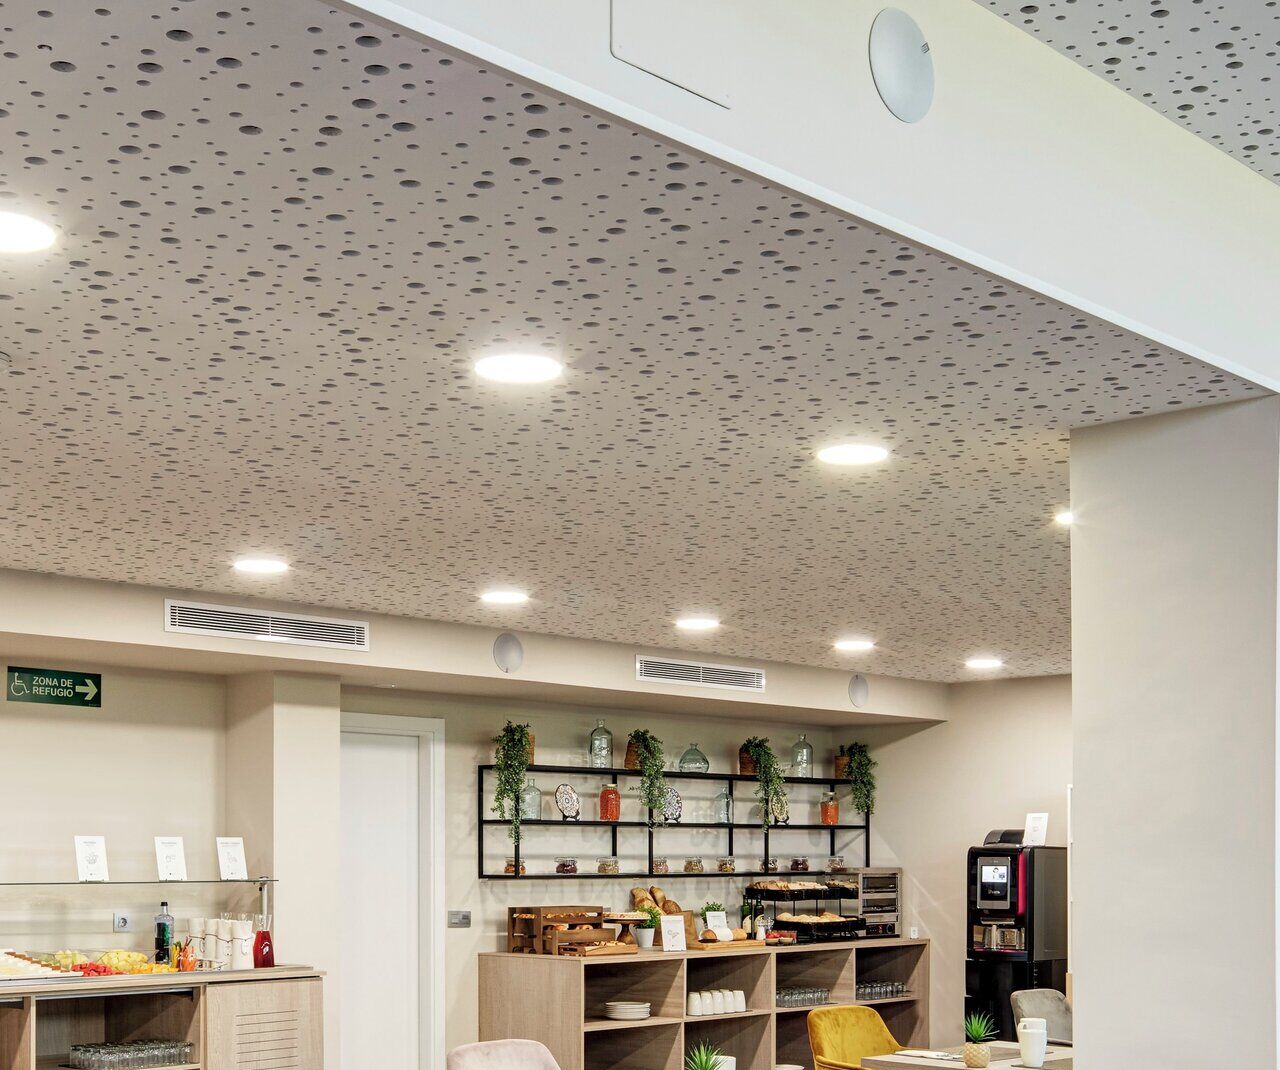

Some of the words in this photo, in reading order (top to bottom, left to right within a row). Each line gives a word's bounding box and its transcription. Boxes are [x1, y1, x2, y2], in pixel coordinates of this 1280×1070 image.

[32, 676, 59, 686] ZONA
[60, 678, 73, 687] DE
[32, 686, 74, 697] REFUGIO
